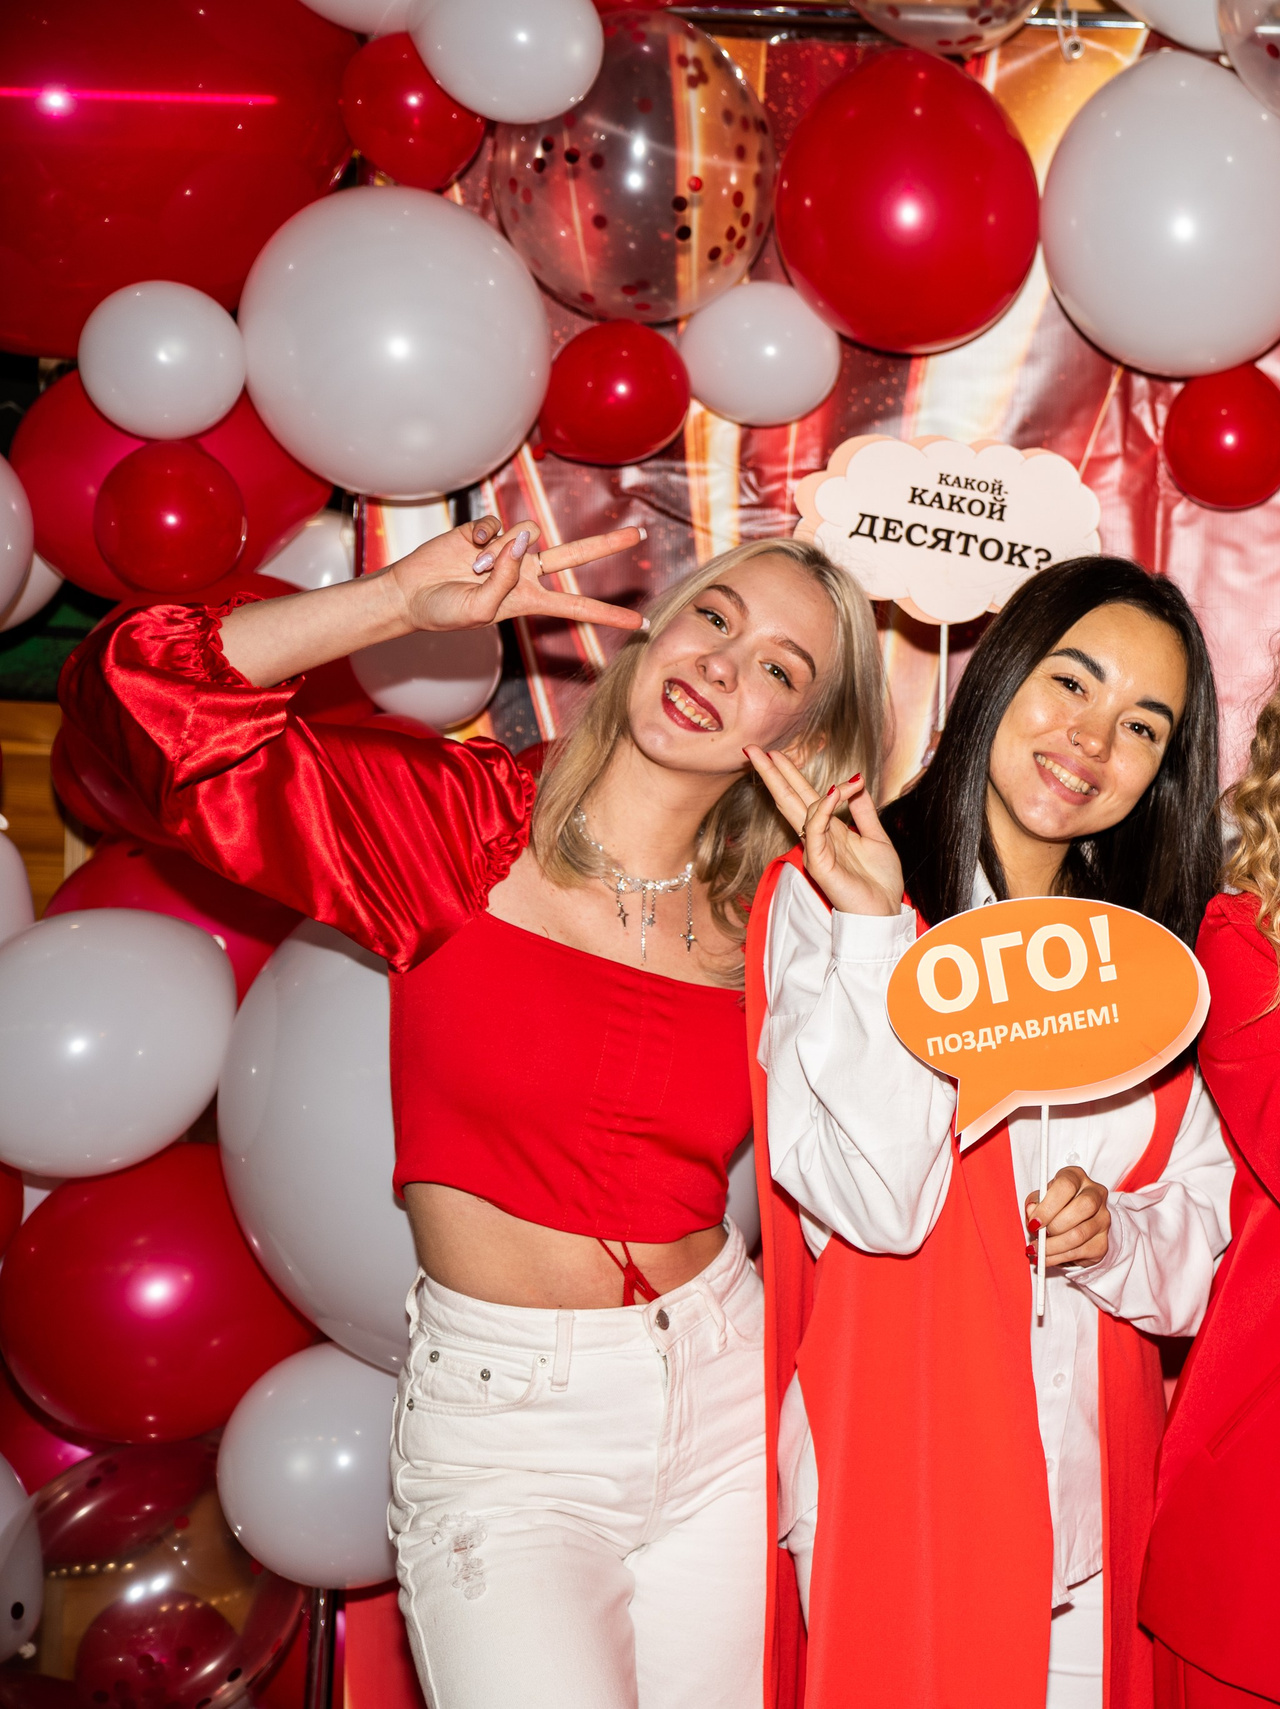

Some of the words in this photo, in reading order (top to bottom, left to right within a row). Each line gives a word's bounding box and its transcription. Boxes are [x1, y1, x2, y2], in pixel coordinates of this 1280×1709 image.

[908, 486, 1007, 522] КАКОЙ
[938, 473, 1009, 496] КАКОЙ-
[849, 513, 1053, 571] ДЕСЯТОК?
[916, 914, 1118, 1014] ОГО!
[926, 1003, 1120, 1057] ПОЗДРАВЛЯЕМ!
